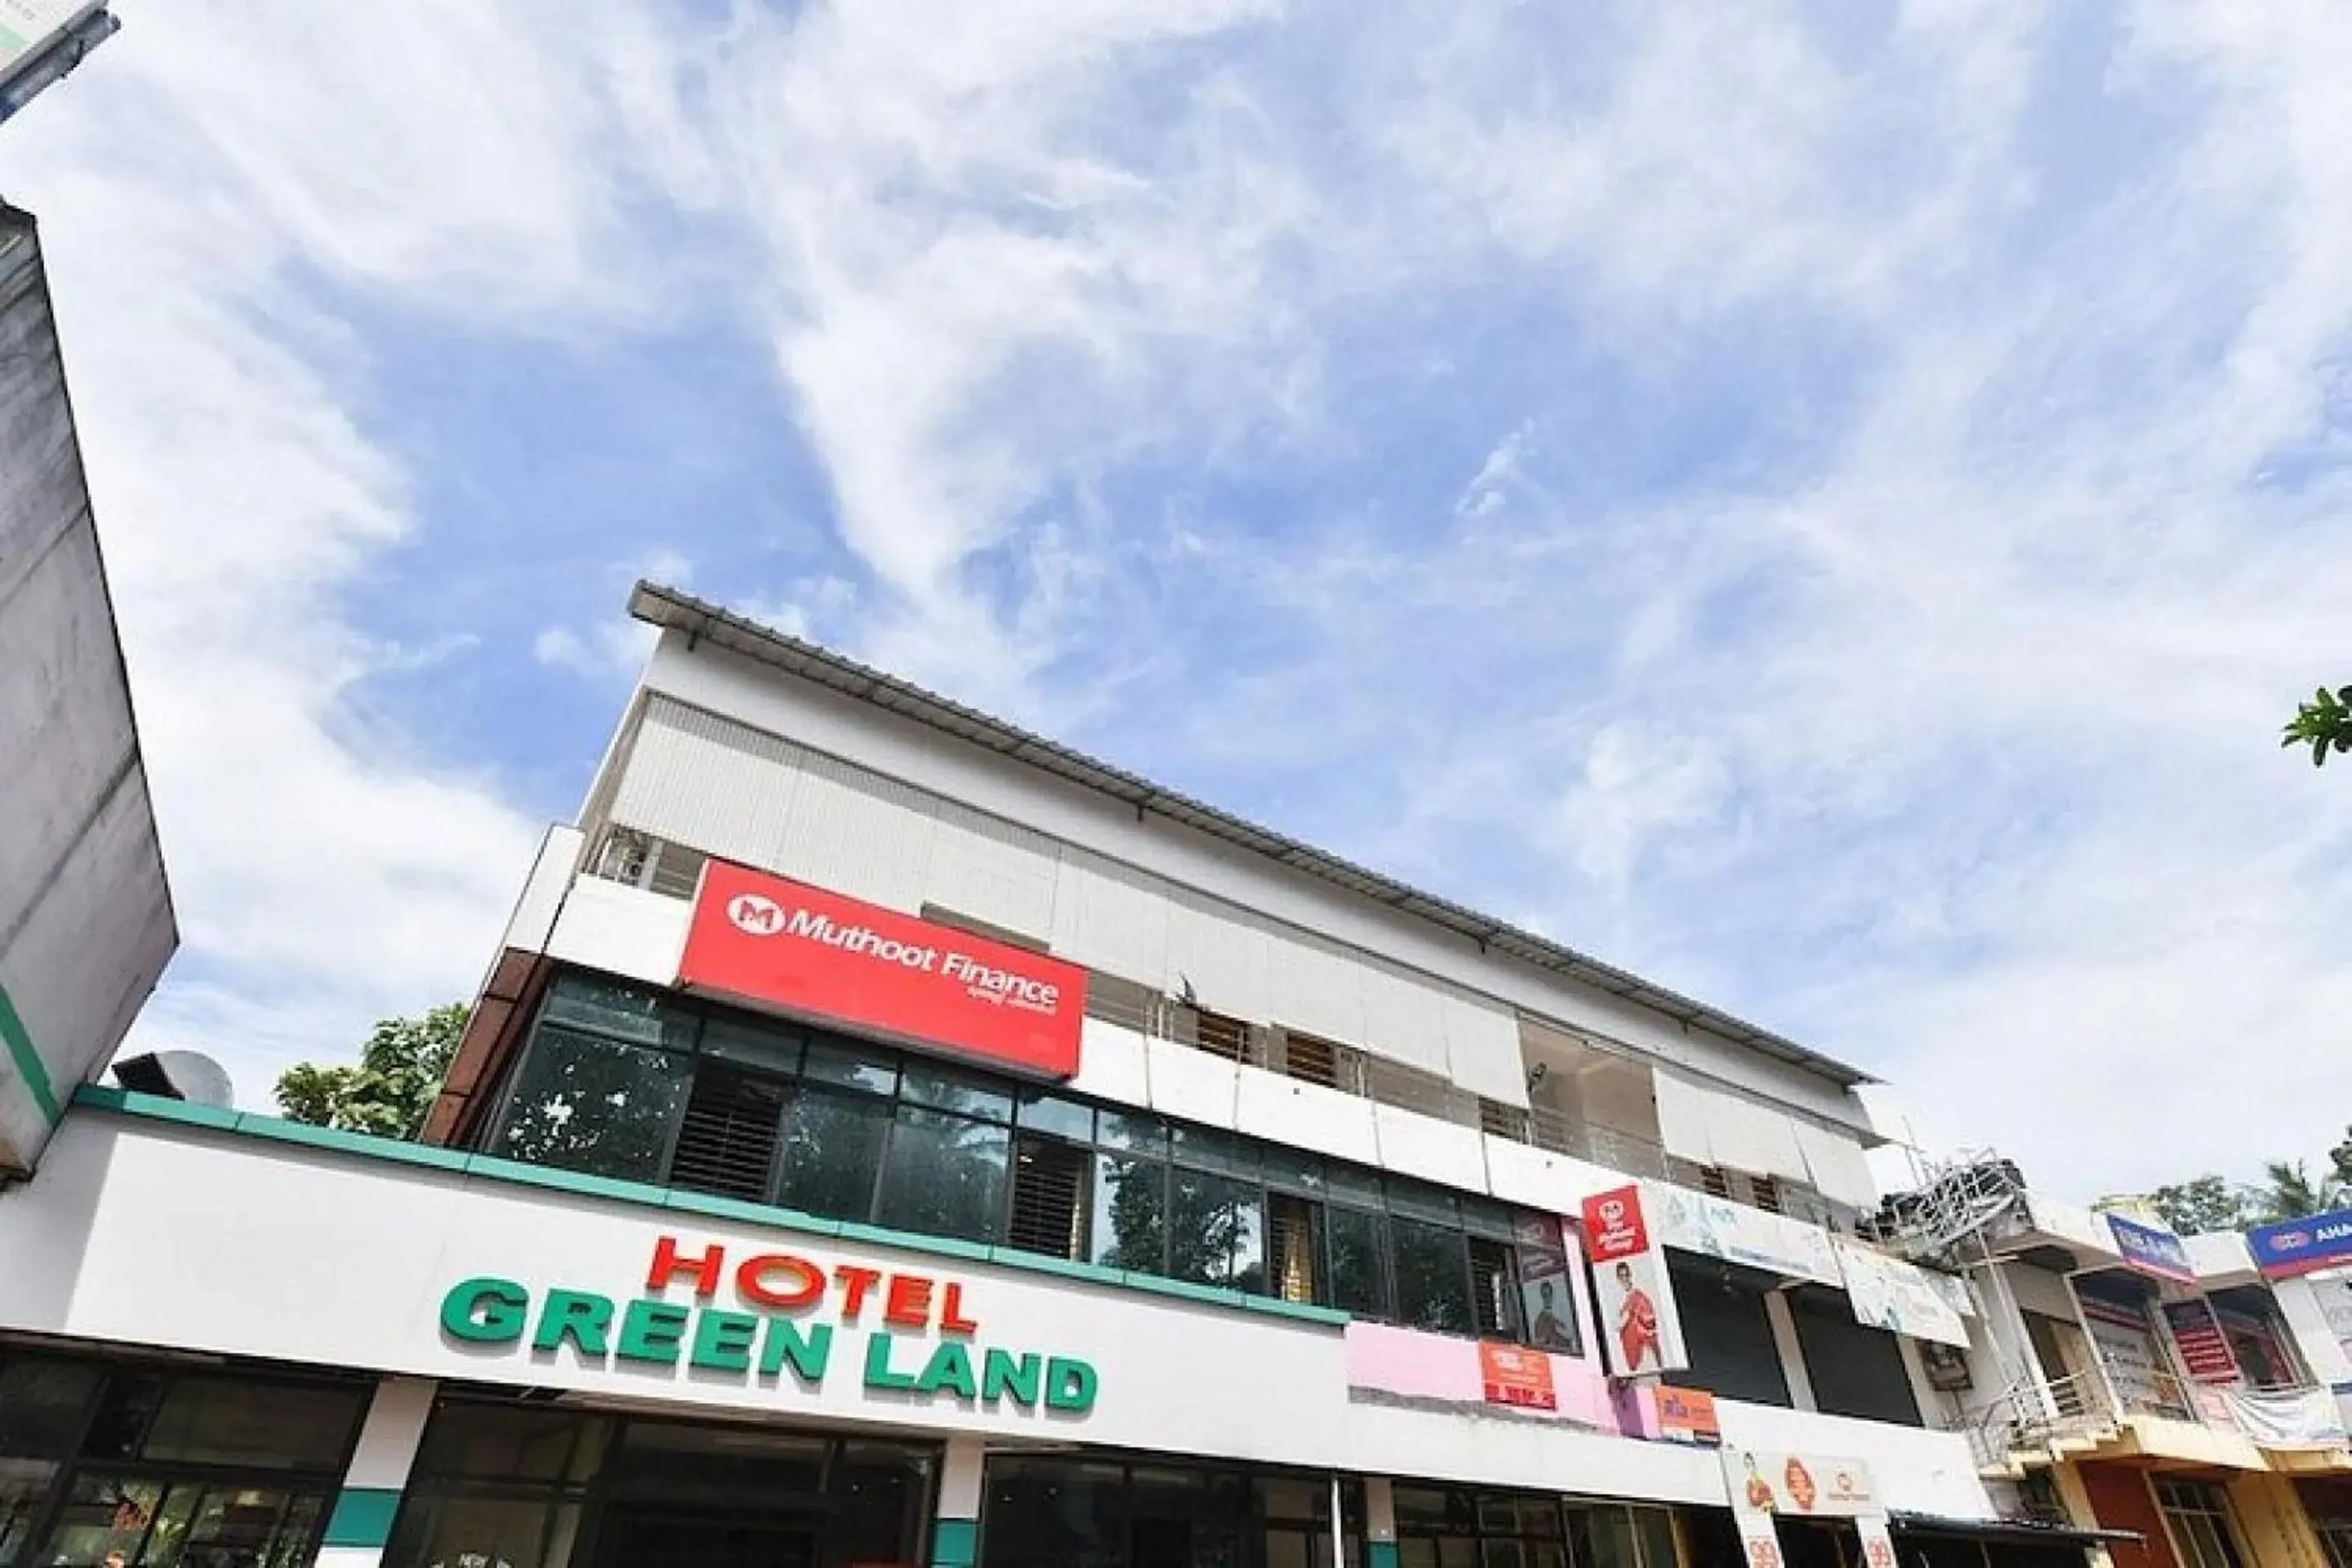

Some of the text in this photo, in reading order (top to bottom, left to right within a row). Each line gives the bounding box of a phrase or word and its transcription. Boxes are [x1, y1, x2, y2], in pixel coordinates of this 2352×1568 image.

[786, 908, 938, 972] Muthoot
[940, 952, 1059, 1005] Finance
[646, 1235, 979, 1334] HOTEL
[440, 1278, 1098, 1412] GREEN LAND
